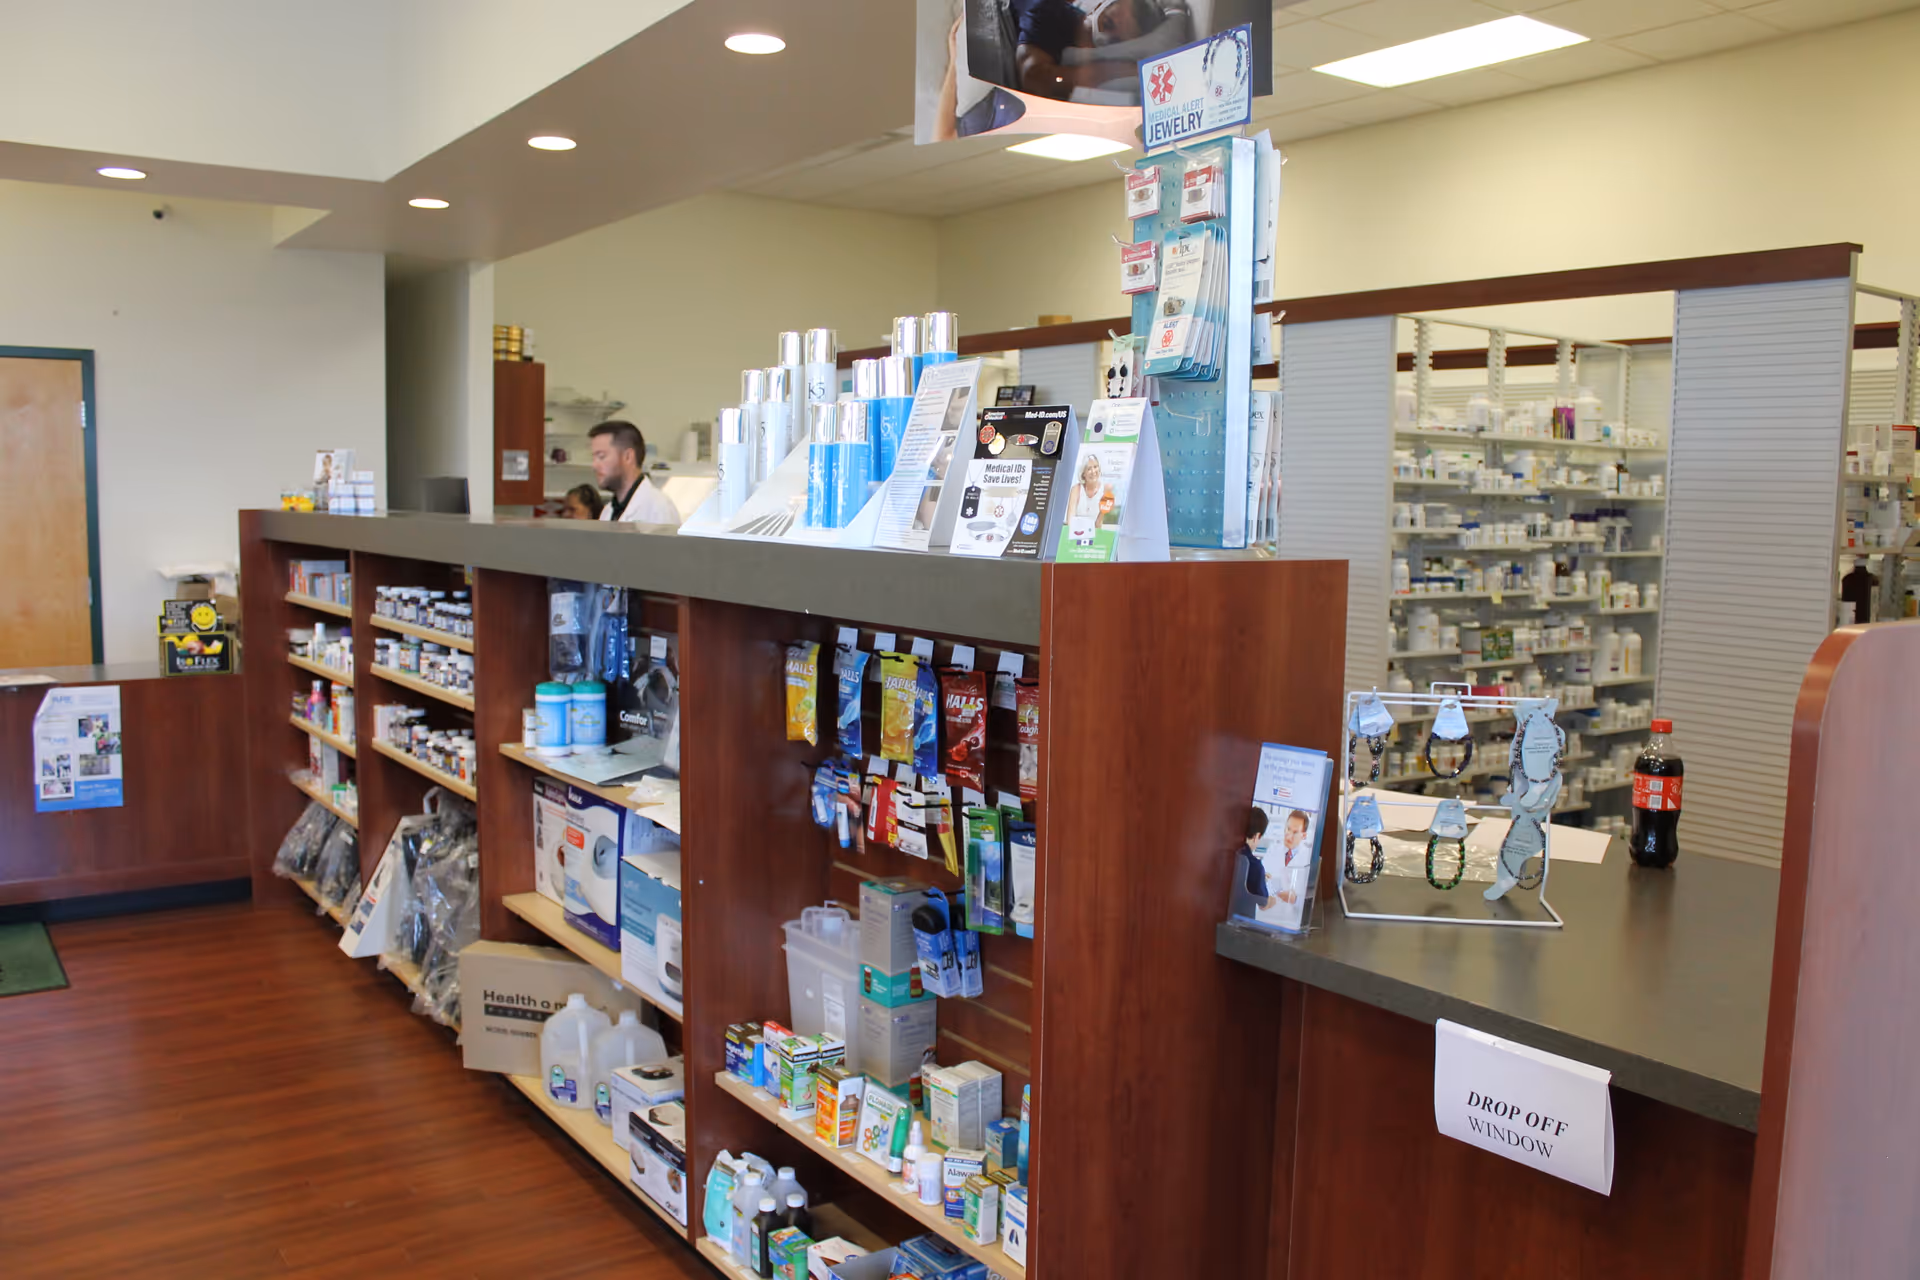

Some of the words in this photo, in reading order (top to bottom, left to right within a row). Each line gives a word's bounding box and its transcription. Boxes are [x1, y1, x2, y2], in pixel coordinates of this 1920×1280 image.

[1149, 107, 1179, 123] MEDICAL
[1182, 97, 1204, 113] ALERT
[1149, 109, 1204, 143] JEWELRY
[1025, 411, 1067, 419] Med-ID.com/US
[984, 463, 1014, 473] Medical
[1014, 464, 1026, 473] IDs
[983, 474, 1001, 484] Save
[1001, 475, 1022, 484] Lives!
[785, 660, 814, 676] HALLS
[946, 693, 985, 711] HALLS
[619, 710, 648, 726] Comfor
[483, 989, 537, 1008] Health
[1467, 1091, 1520, 1121] DROP
[1525, 1111, 1569, 1137] OFF
[1467, 1115, 1554, 1159] WINDOW
